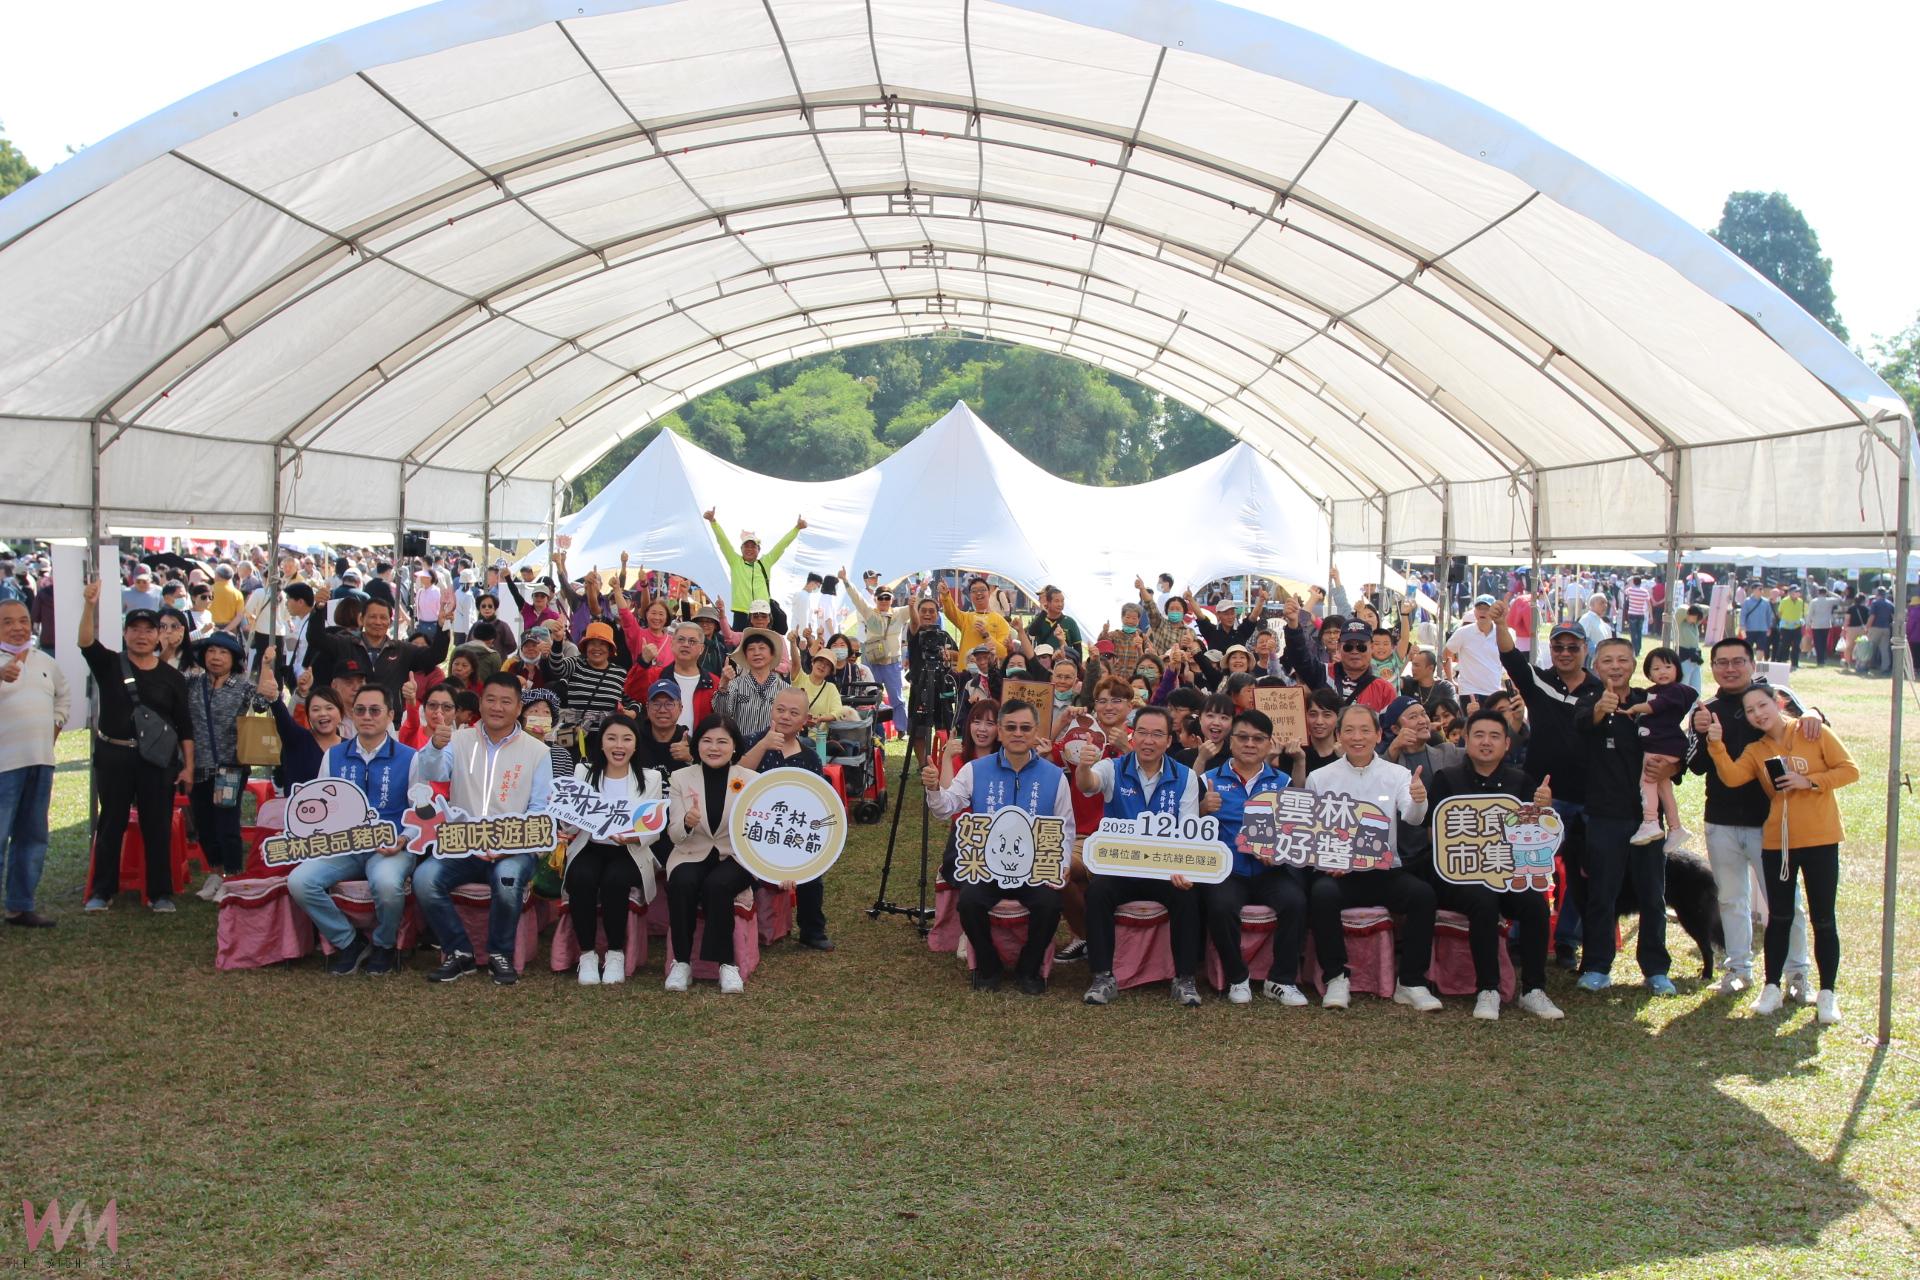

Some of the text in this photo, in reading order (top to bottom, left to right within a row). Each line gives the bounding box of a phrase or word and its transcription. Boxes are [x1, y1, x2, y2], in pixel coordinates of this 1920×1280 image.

[548, 806, 597, 830] It's Our Time
[553, 779, 632, 836] 雲林上場
[745, 801, 807, 827] 2025 雲林
[1277, 790, 1359, 830] 雲林
[1446, 805, 1509, 837] 美食
[437, 815, 552, 855] 趣味遊戲
[742, 820, 822, 854] 滷肉飯節
[1103, 815, 1215, 841] 2025 12.06
[1098, 847, 1217, 867] 會場位置 古坑綠色隧道
[1275, 832, 1354, 870] 好醬
[1448, 842, 1516, 874] 市集
